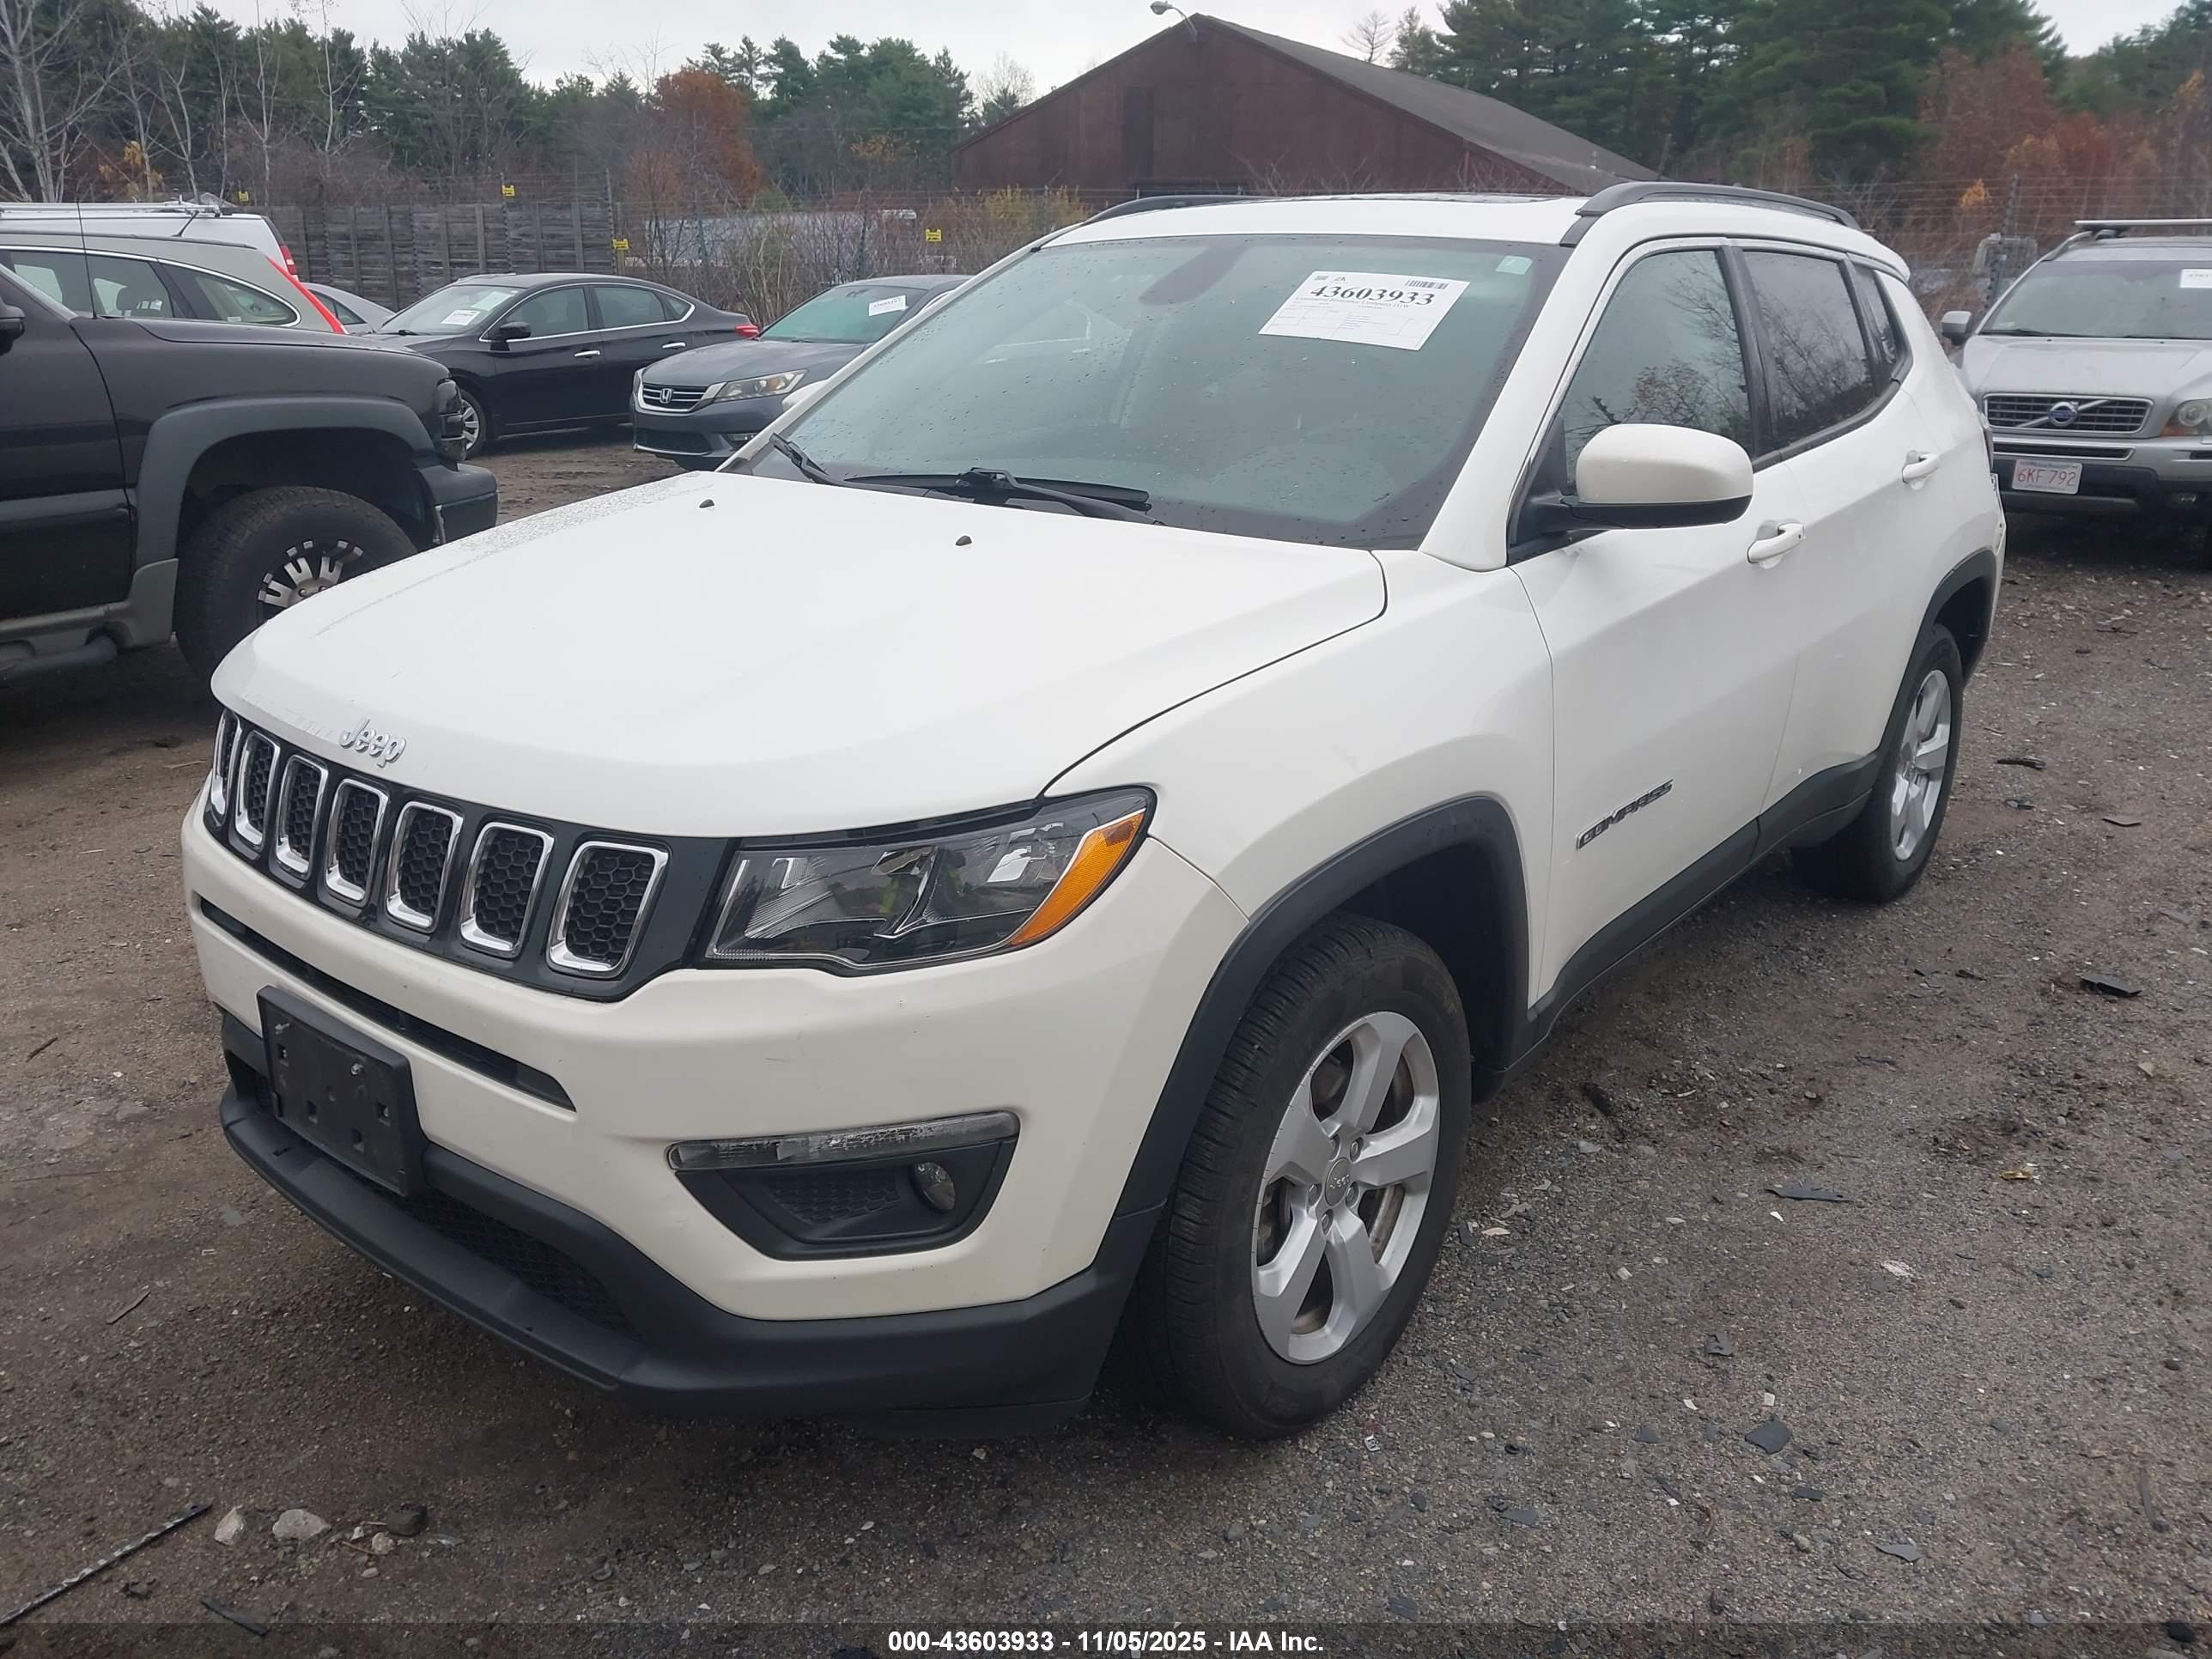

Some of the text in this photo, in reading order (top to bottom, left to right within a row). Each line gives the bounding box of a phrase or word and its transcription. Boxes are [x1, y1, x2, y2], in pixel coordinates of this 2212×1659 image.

[1310, 286, 1435, 305] 43603933
[2018, 469, 2076, 487] 6KF 792
[339, 717, 406, 769] Jeep
